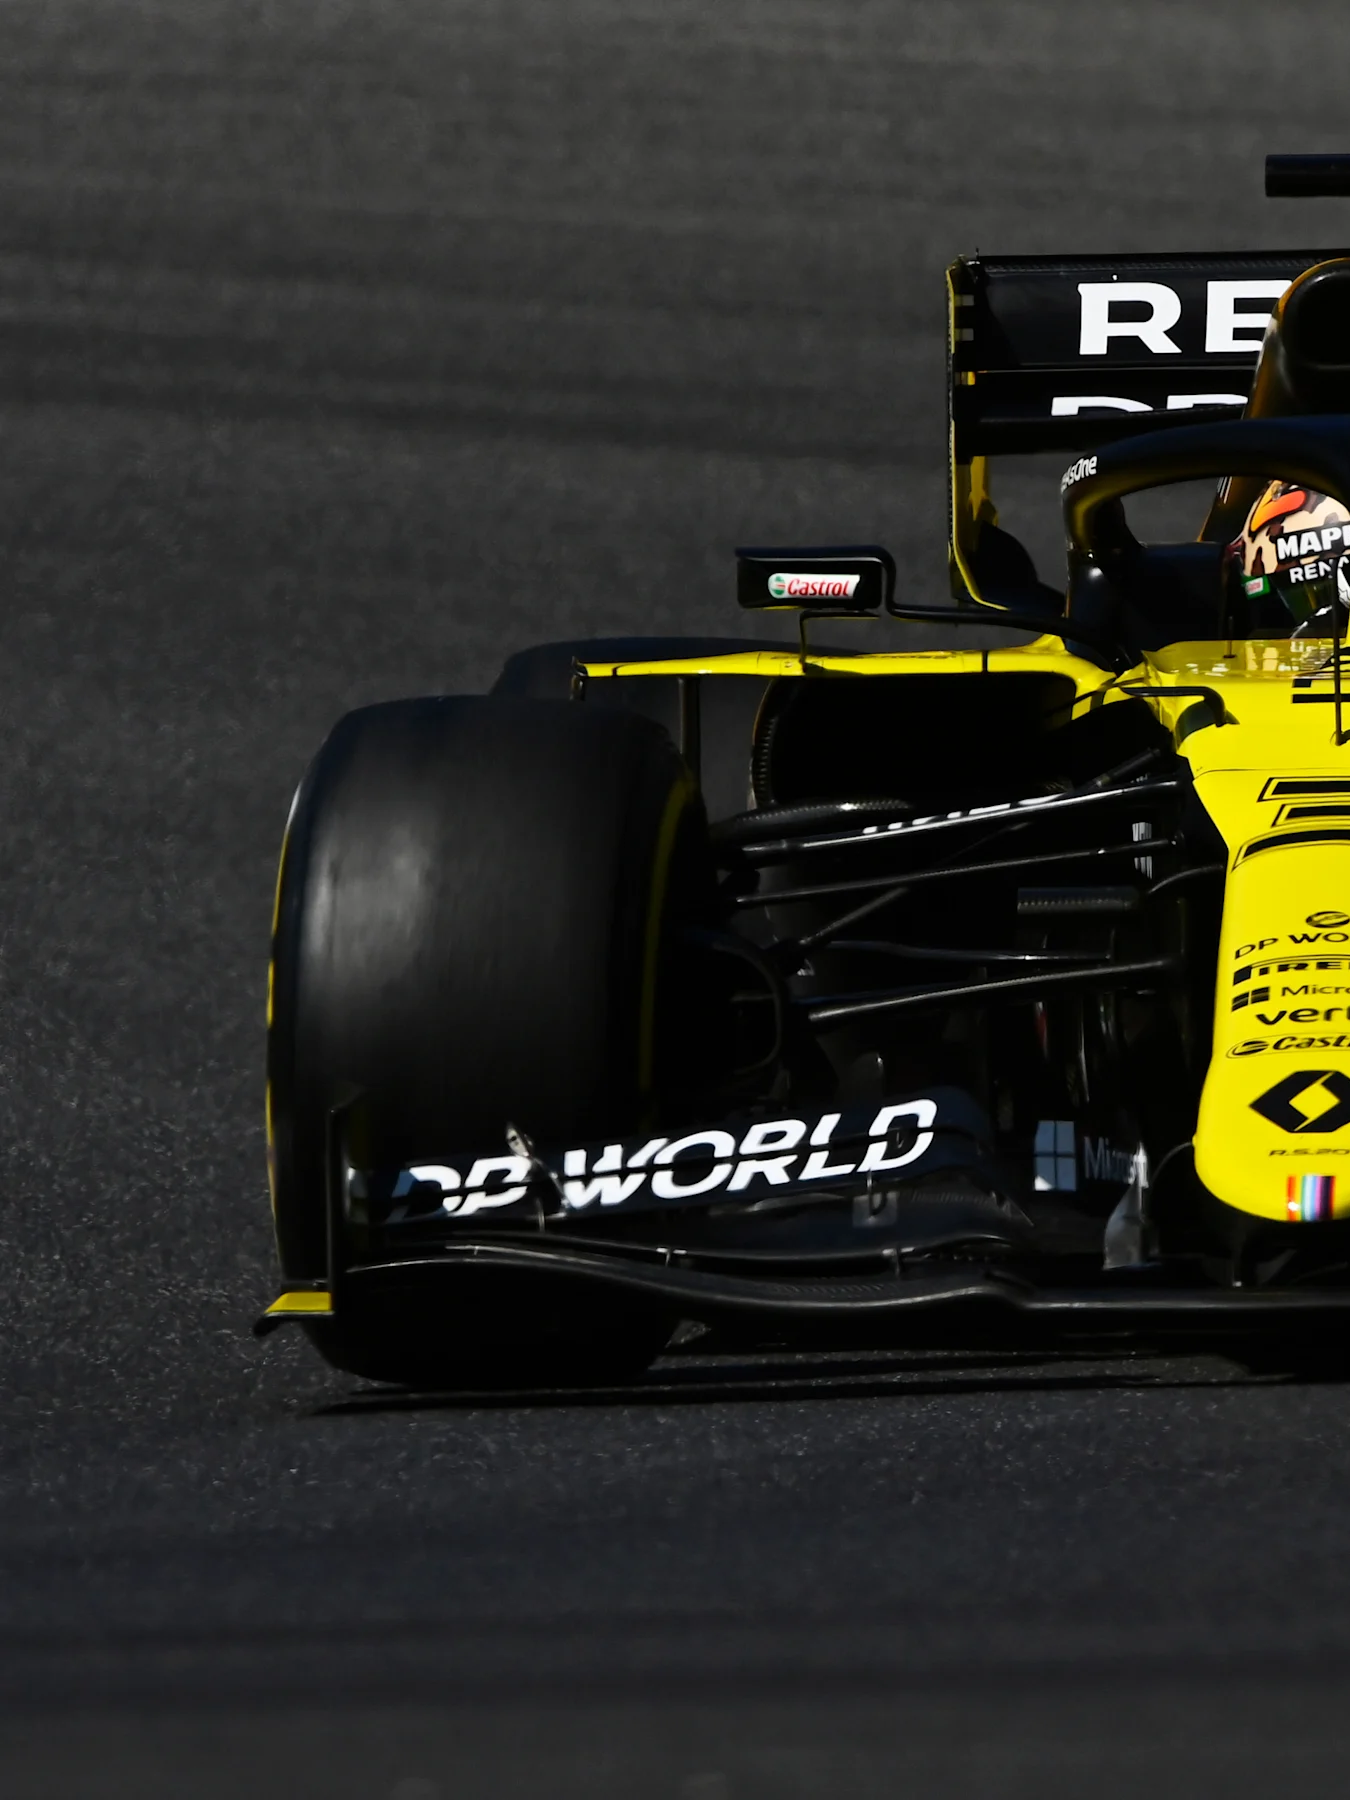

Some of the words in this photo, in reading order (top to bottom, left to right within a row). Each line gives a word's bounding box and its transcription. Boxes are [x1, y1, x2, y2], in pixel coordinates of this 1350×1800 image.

[788, 577, 850, 597] Castrol
[1235, 937, 1279, 959] DP
[562, 1098, 939, 1207] WORLD
